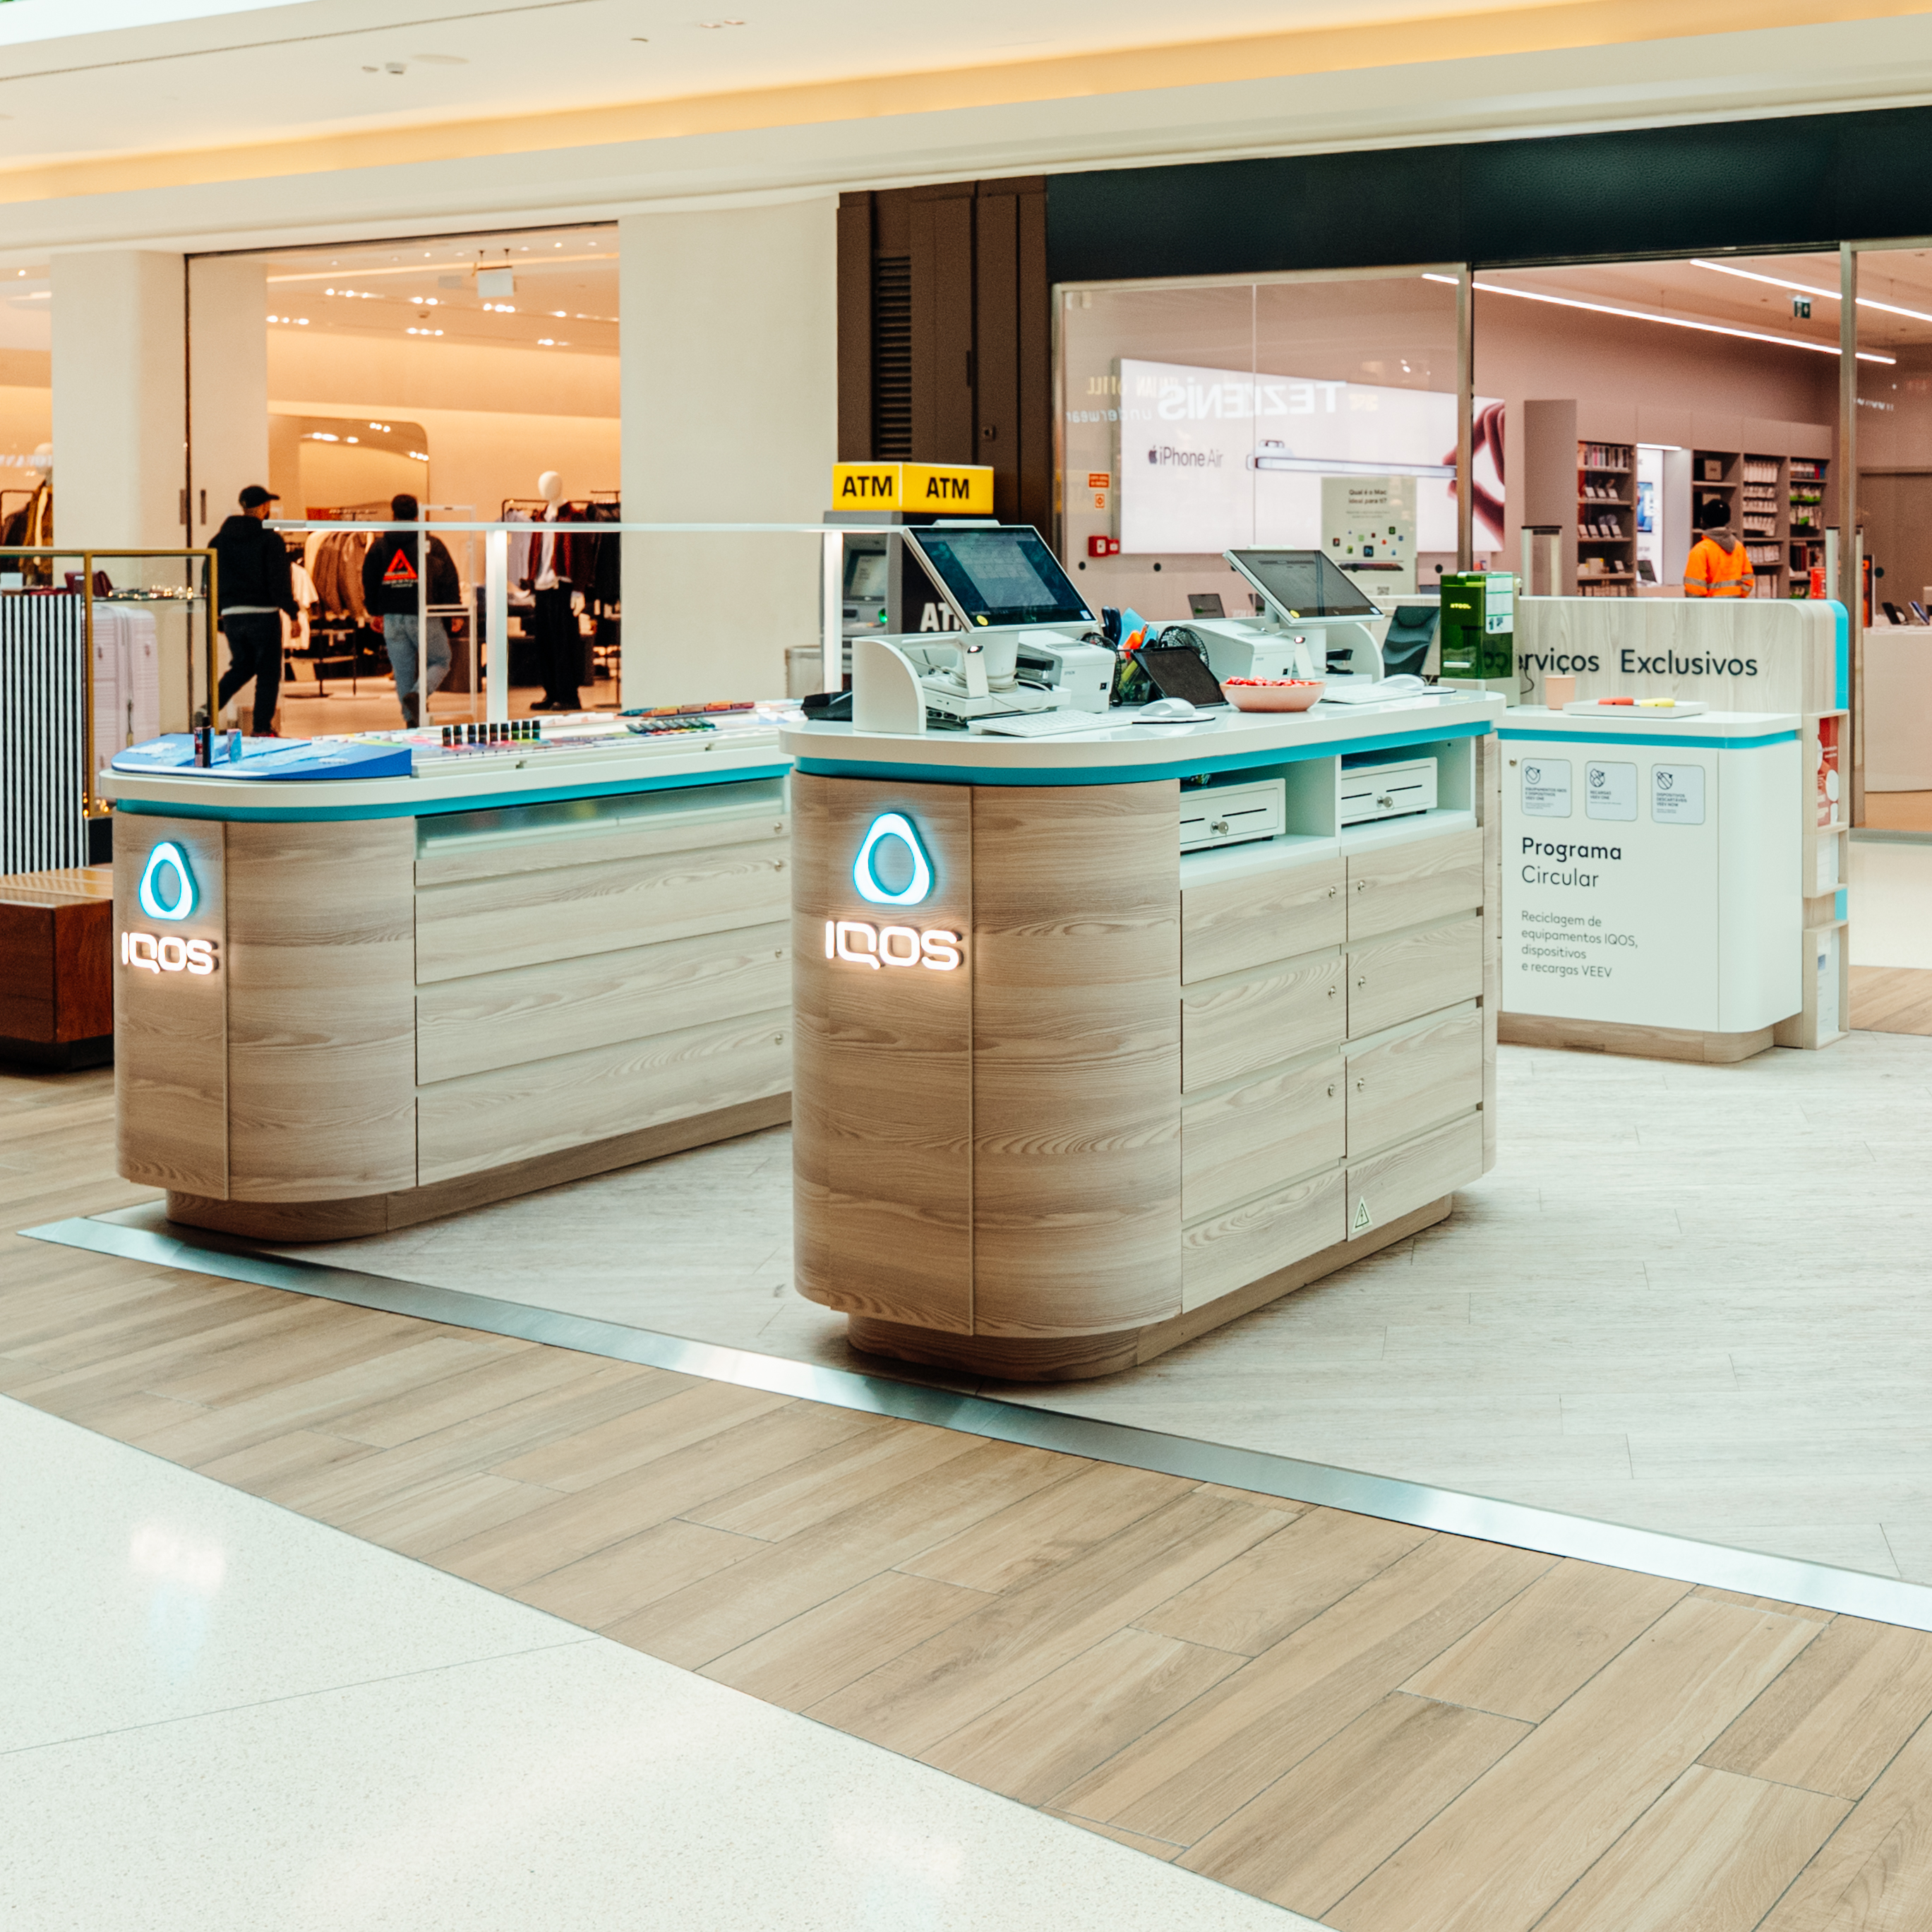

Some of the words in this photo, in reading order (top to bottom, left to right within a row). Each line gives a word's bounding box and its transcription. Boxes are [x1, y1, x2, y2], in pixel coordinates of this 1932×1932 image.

[1160, 446, 1205, 467] iPhone
[1207, 449, 1223, 467] Air
[842, 476, 893, 497] ATM
[926, 477, 970, 499] ATM
[1518, 647, 1600, 676] rviços
[1621, 649, 1758, 676] Exclusivos
[1523, 836, 1621, 863] Programa
[1522, 865, 1599, 887] Circular
[1522, 911, 1585, 928] Reciclagem
[1588, 916, 1602, 927] de
[825, 920, 961, 971] IQOS
[1521, 929, 1602, 944] equipamentos
[1604, 932, 1638, 949] IQOS,
[121, 932, 215, 975] IQOS
[1521, 944, 1587, 959] dispositivos
[1531, 964, 1578, 978] recargas
[1581, 965, 1612, 978] VEEV
